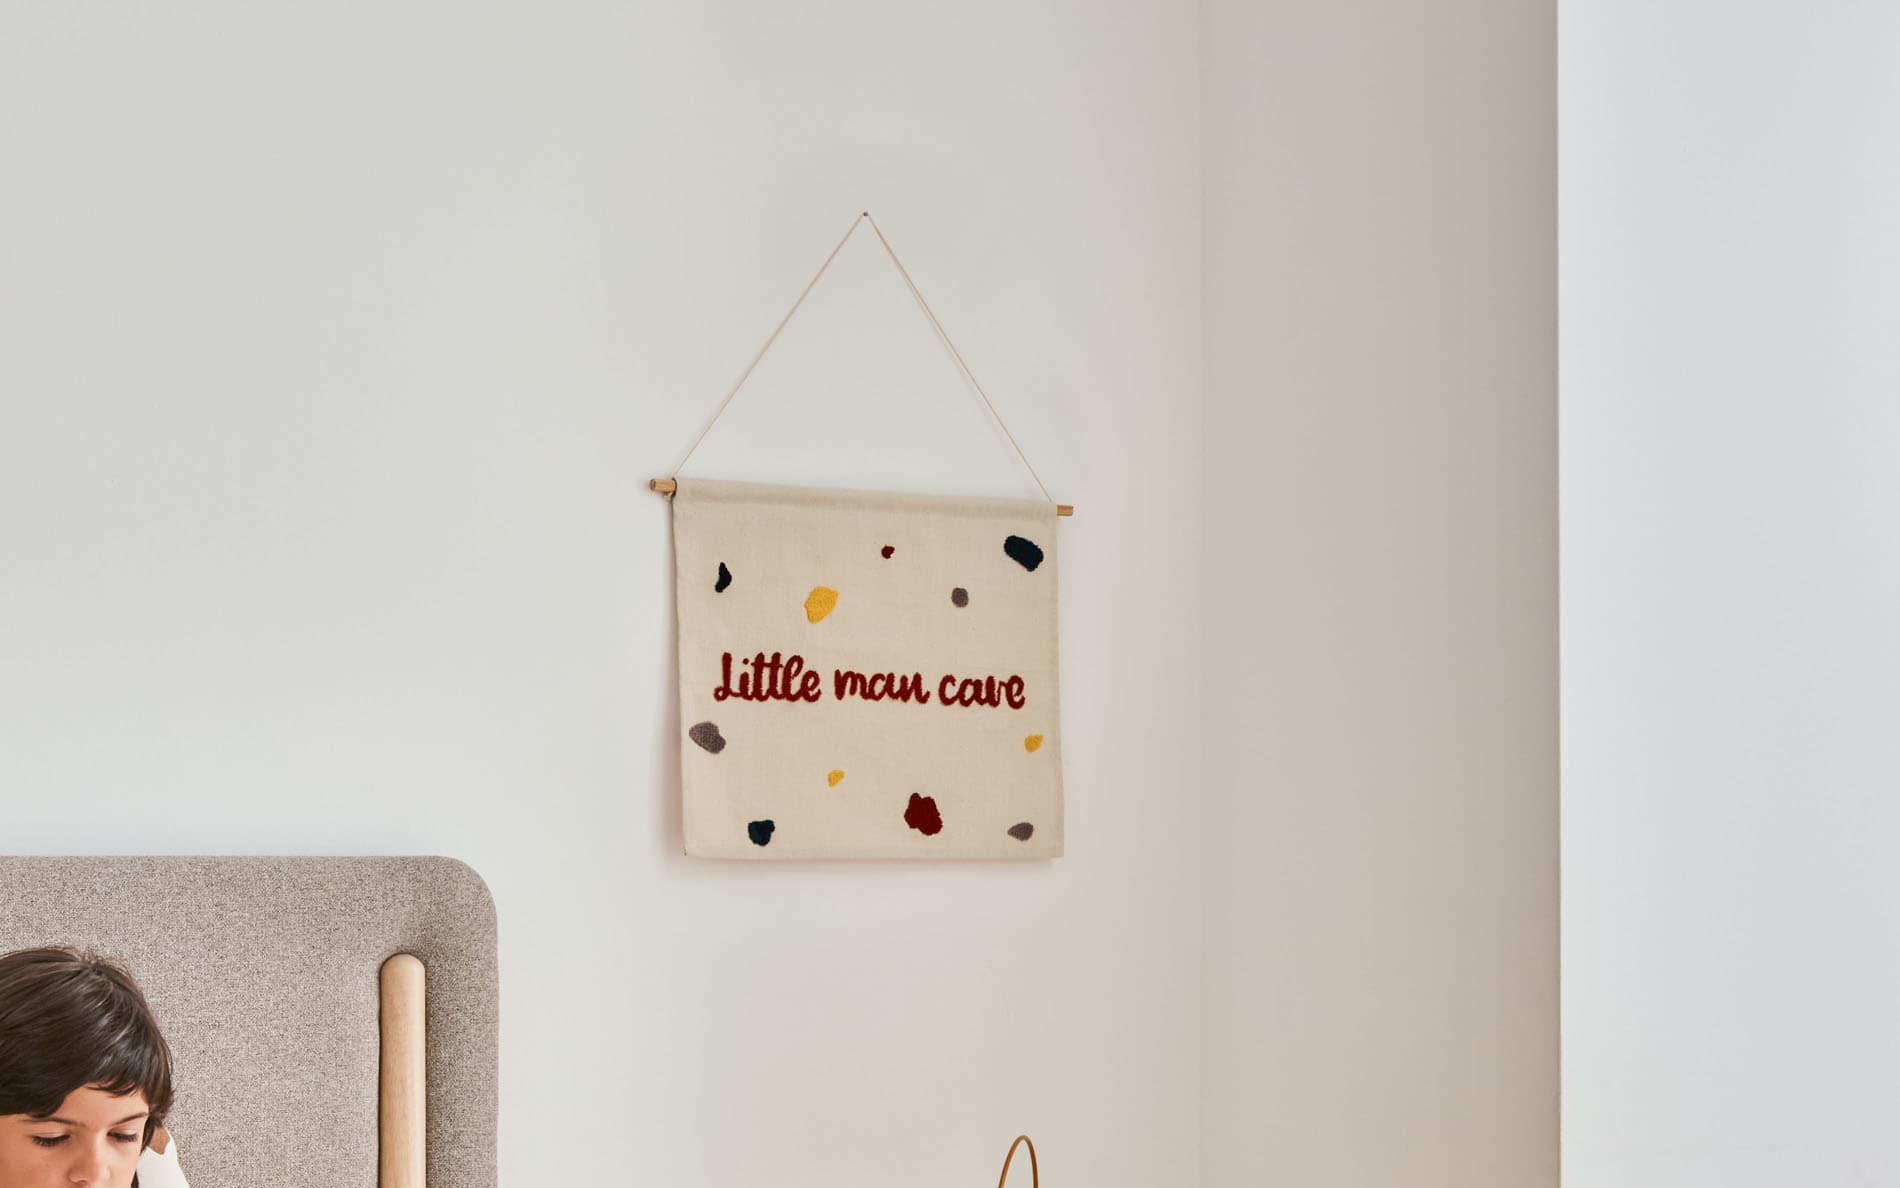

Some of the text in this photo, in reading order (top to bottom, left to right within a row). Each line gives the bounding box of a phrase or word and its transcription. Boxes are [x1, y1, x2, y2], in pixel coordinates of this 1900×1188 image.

[713, 652, 1026, 710] Little man cave
